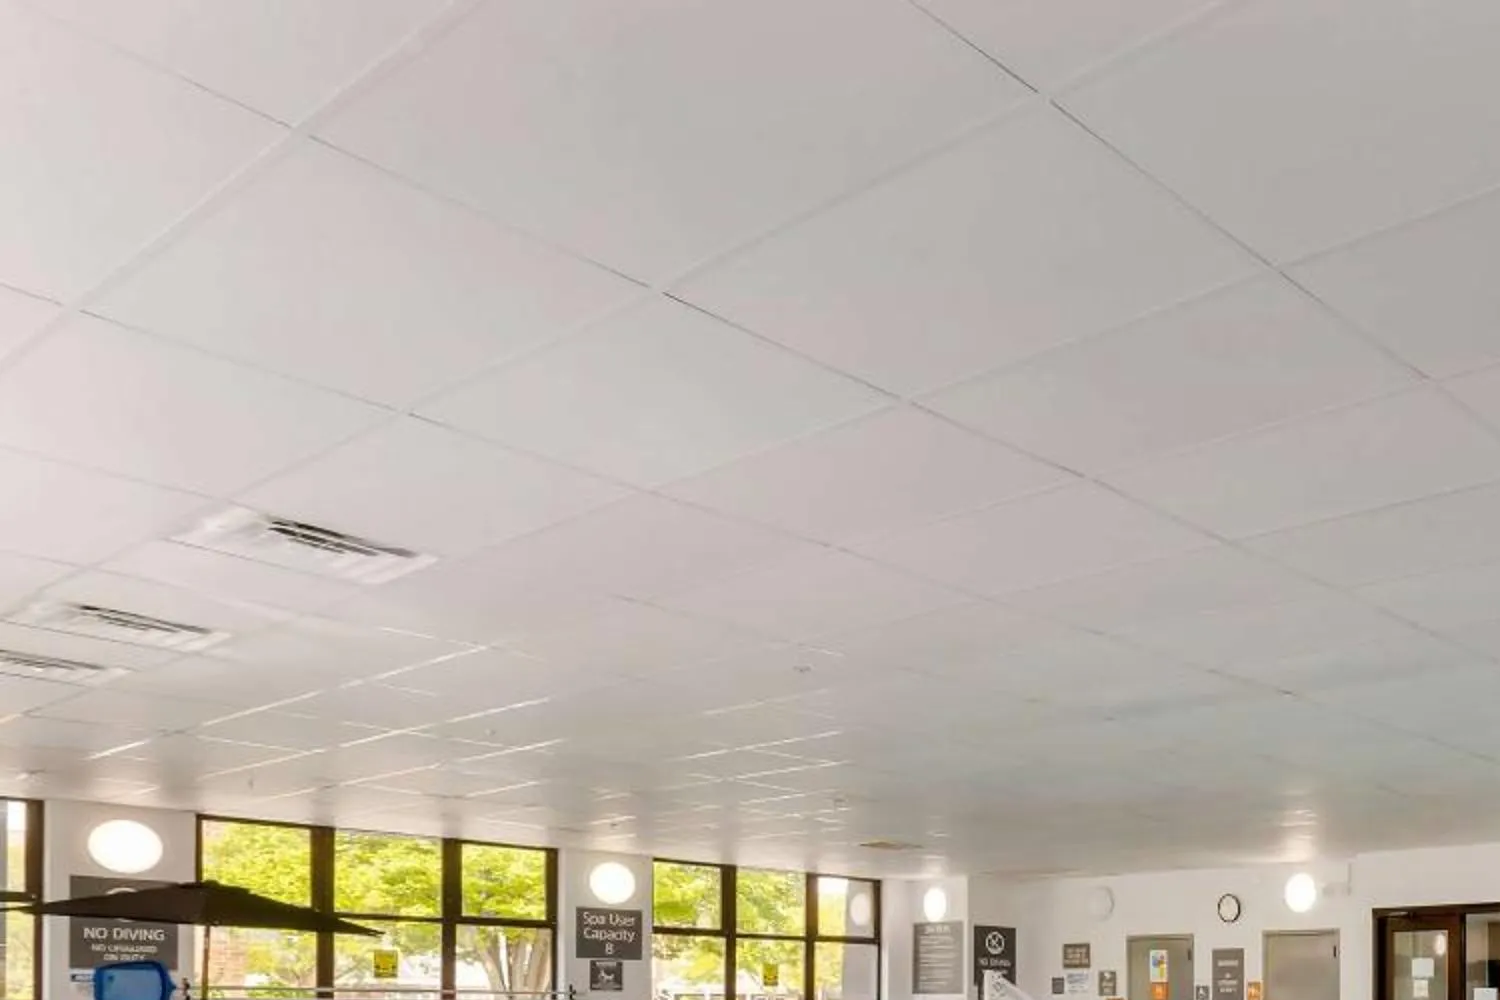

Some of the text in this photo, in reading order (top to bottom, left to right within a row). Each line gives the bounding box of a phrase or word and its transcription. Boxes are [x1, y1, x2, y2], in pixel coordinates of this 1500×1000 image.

[583, 911, 635, 926] Spa User
[83, 927, 165, 941] NO DIVING
[583, 927, 636, 943] Capacity
